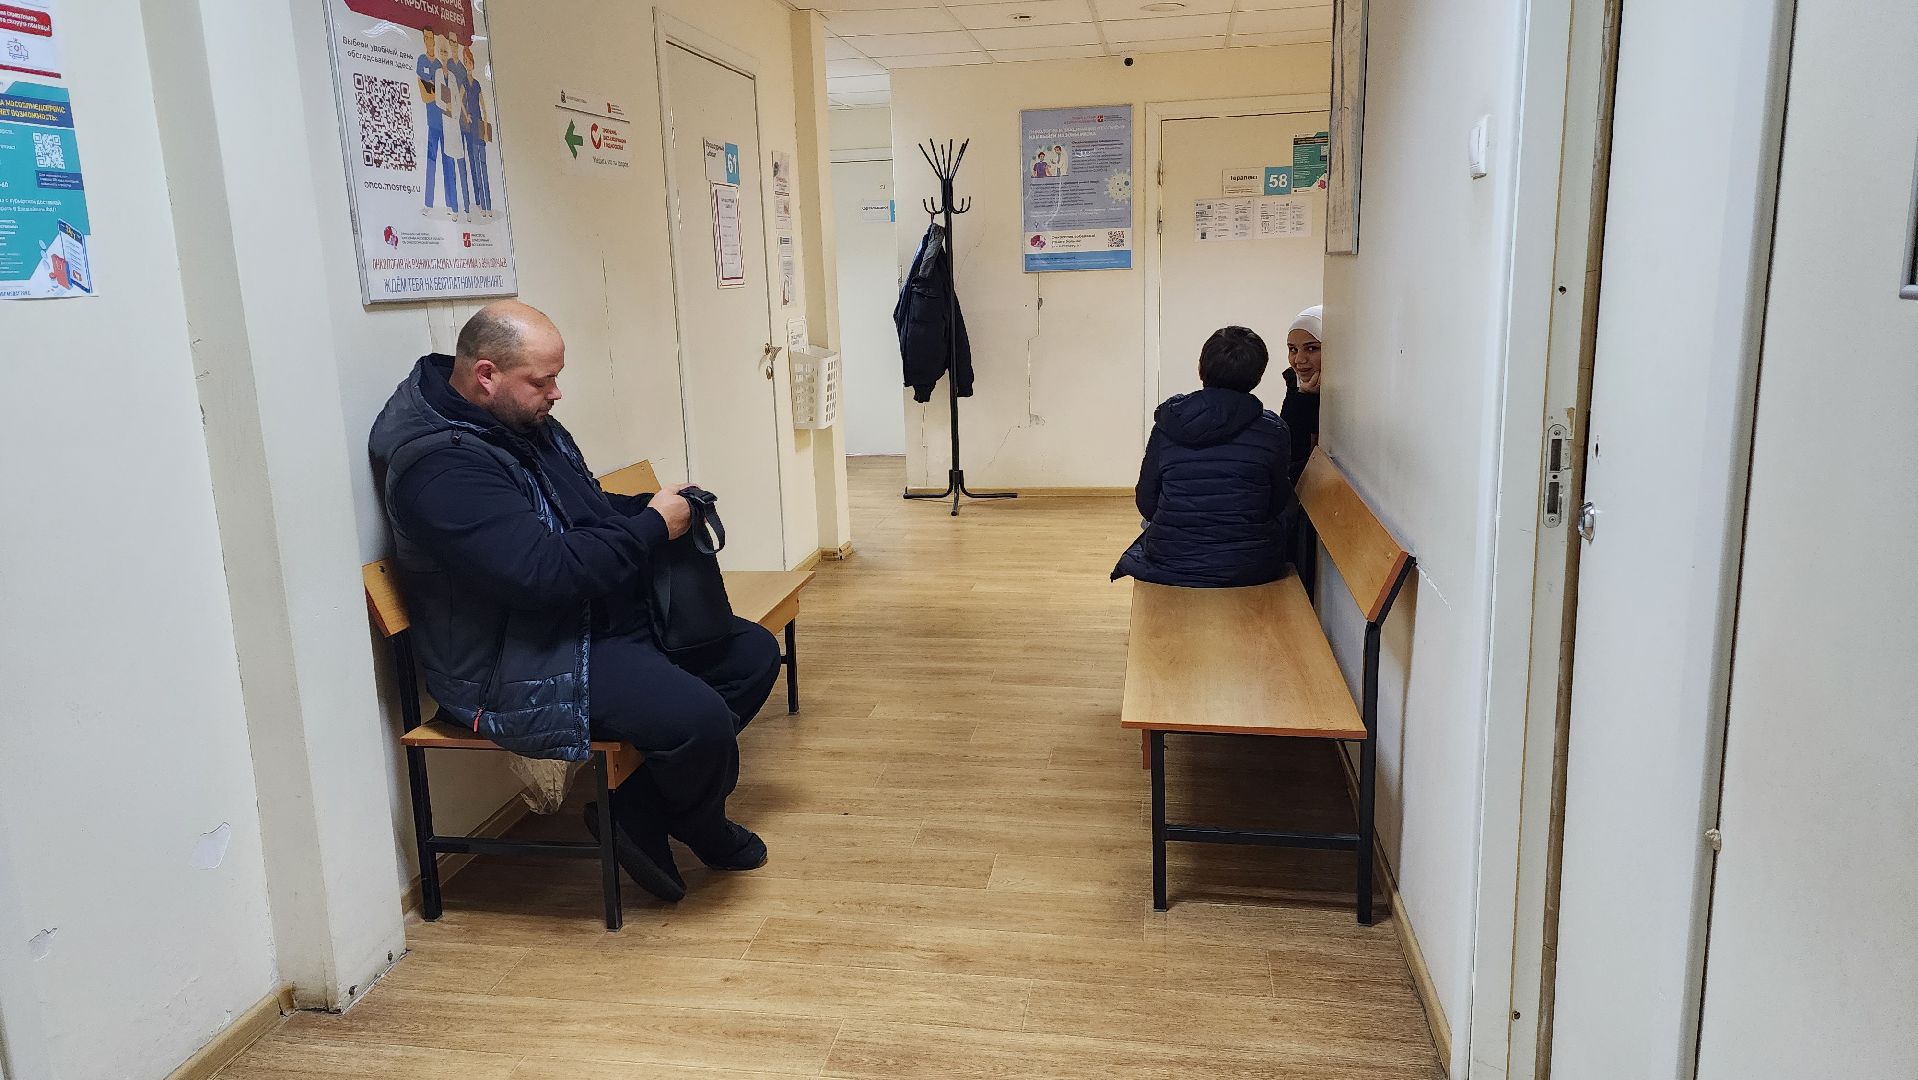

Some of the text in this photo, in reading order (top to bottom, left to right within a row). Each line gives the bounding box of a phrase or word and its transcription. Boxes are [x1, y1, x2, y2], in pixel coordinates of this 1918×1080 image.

[440, 7, 466, 27] ДВЕРЕЙ
[342, 36, 414, 60] Выбери удобный день
[347, 50, 394, 67] обследования
[727, 153, 737, 175] 61
[363, 181, 422, 195] onco.mosreg.ru
[1269, 174, 1288, 187] 58
[384, 276, 407, 293] ЖДЁМ
[407, 277, 424, 292] ТЕБЯ
